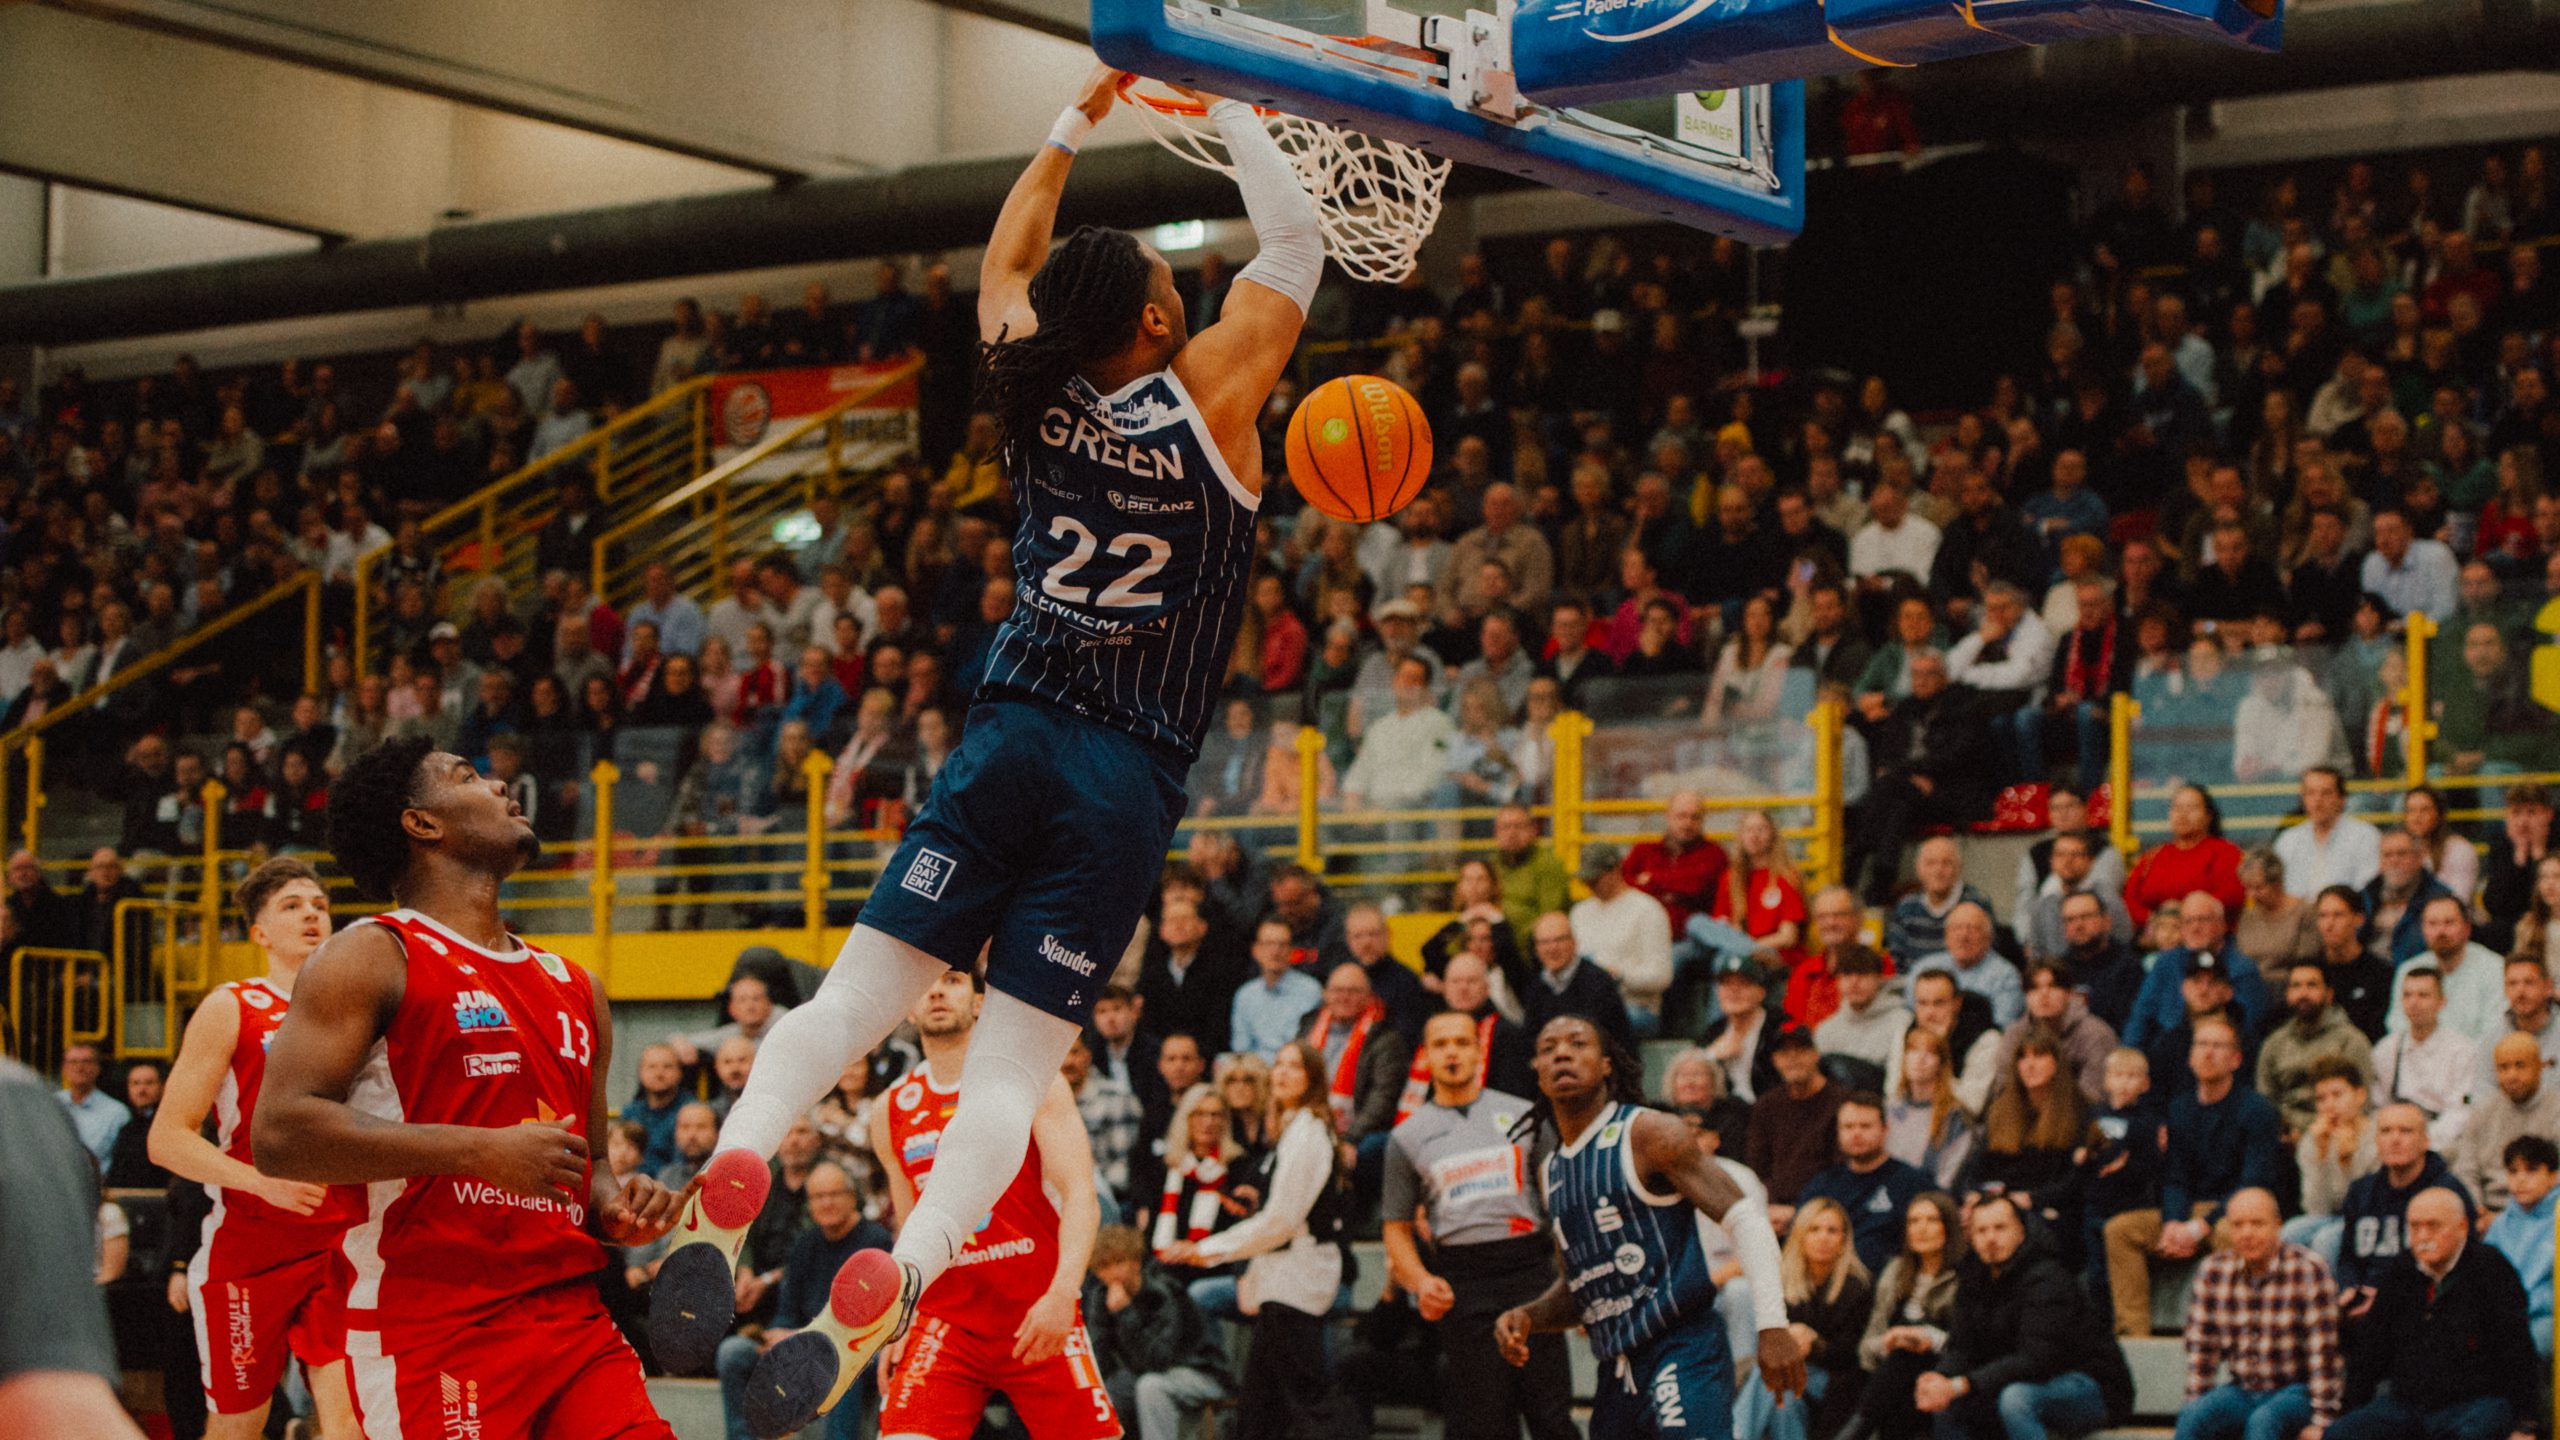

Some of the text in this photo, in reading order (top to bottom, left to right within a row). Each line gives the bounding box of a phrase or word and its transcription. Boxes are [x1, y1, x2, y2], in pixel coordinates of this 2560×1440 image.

[1684, 115, 1734, 141] BARMER
[1040, 406, 1185, 480] GREEN
[1034, 478, 1084, 502] PEGEOT
[1128, 500, 1195, 512] PFLANZ
[1041, 516, 1172, 608] 22
[1104, 635, 1133, 646] 1886
[913, 864, 940, 881] DAY
[919, 855, 941, 872] ALL
[908, 874, 934, 893] ENT.
[1038, 934, 1097, 977] Stauder
[452, 989, 503, 1011] JUM
[557, 1011, 591, 1067] 13
[956, 1237, 1035, 1266] alenWIND
[1091, 1387, 1111, 1422] 5
[1655, 1362, 1687, 1427] VBW
